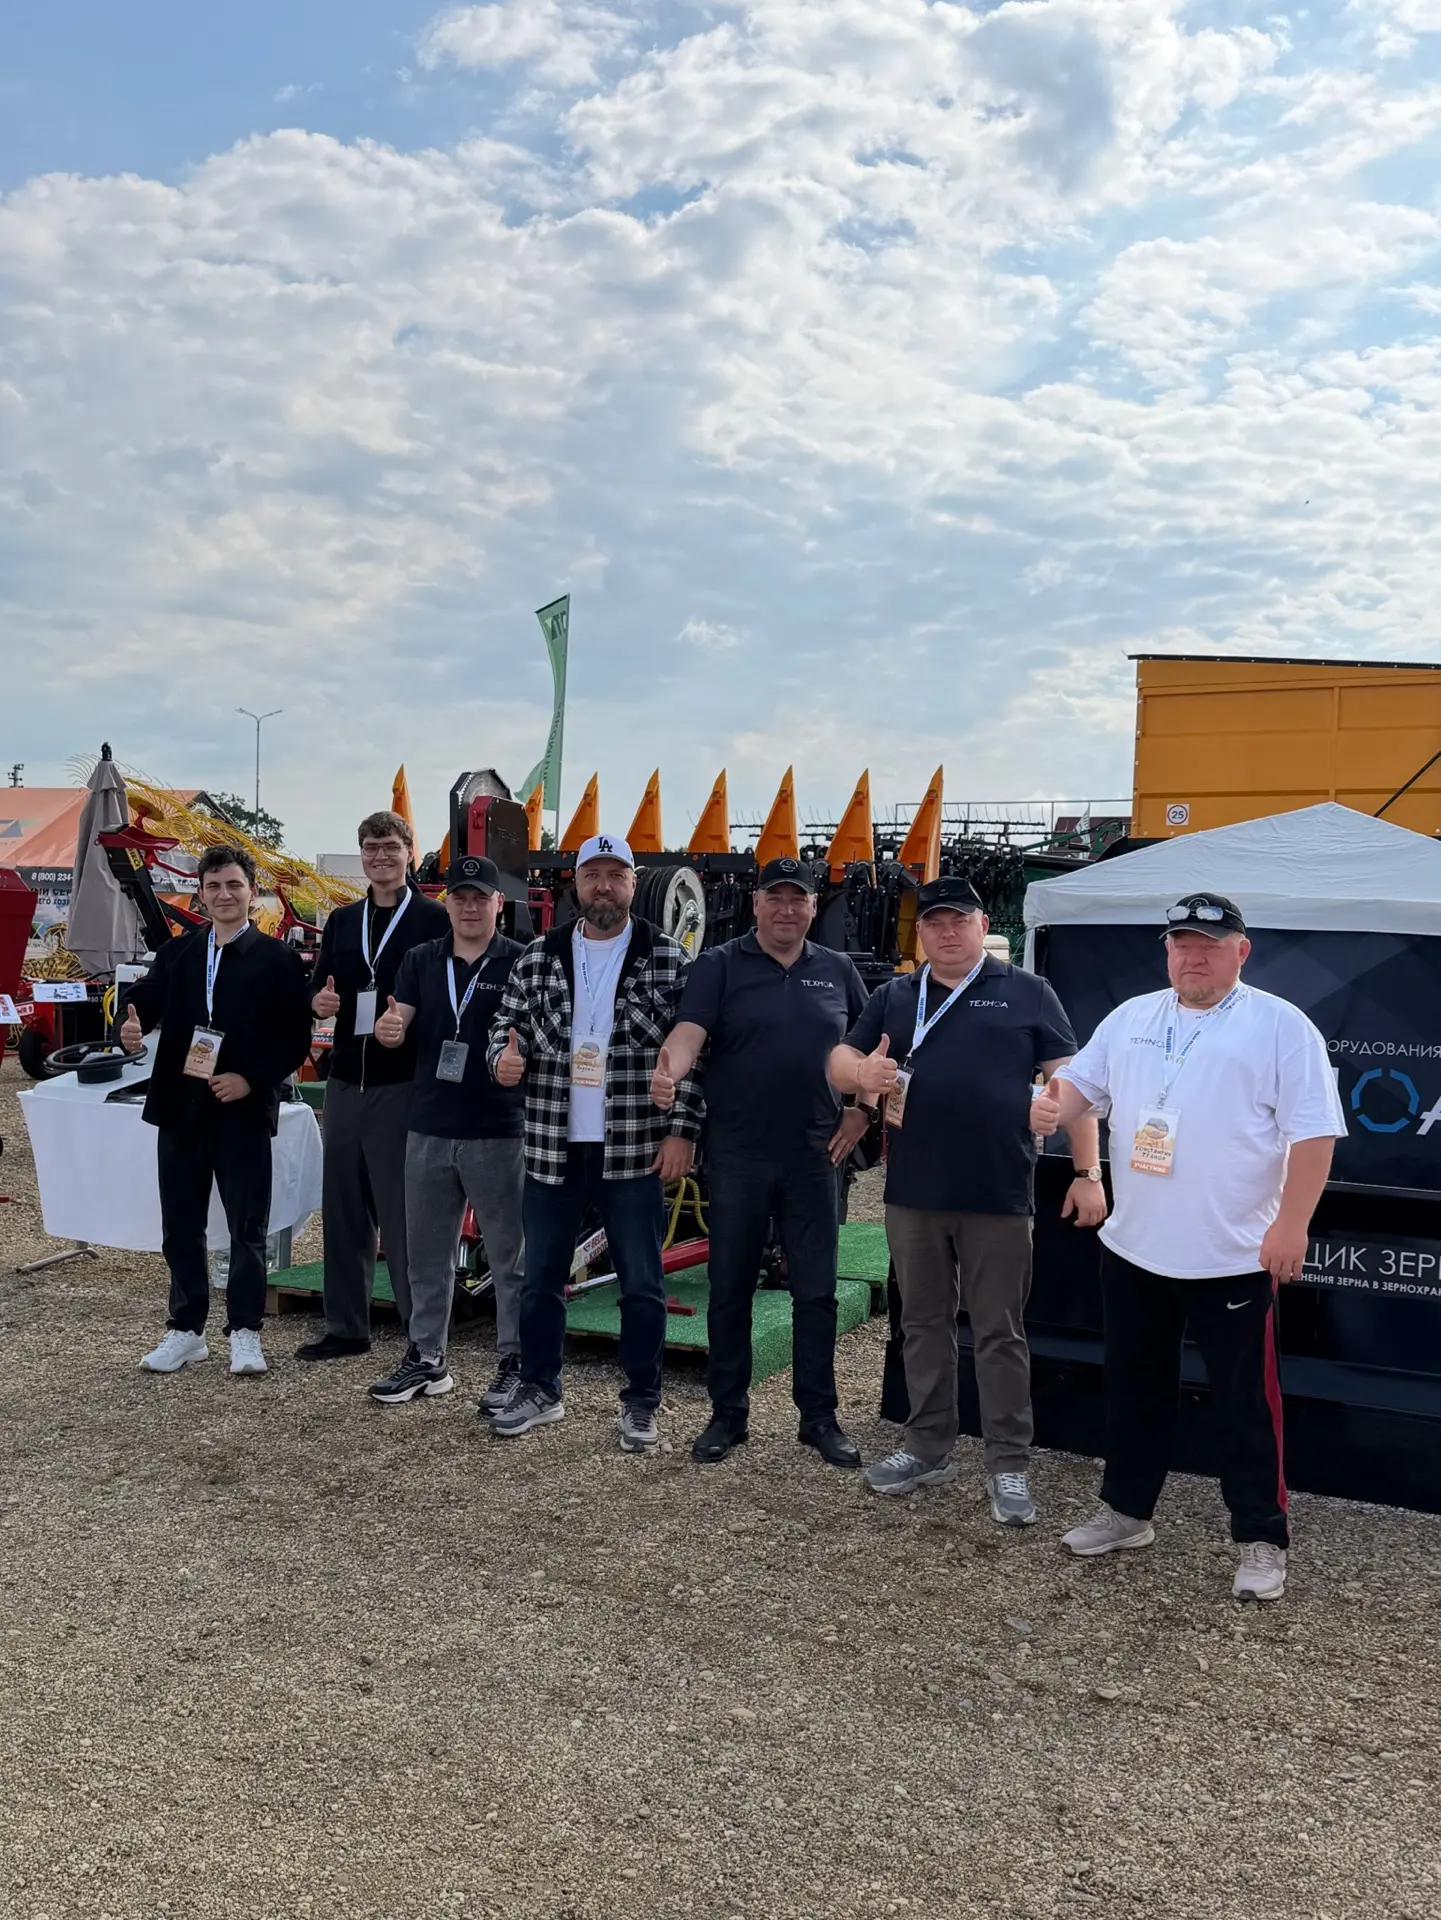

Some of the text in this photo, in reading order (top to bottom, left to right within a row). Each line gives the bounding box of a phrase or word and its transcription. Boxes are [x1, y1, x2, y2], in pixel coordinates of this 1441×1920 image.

[1171, 810, 1185, 820] 25
[598, 836, 613, 853] LA
[31, 872, 37, 880] 8
[38, 872, 56, 882] (800)
[968, 1000, 1009, 1009] ТЕХНОА
[1130, 1037, 1165, 1049] TEHNO
[1378, 1249, 1441, 1280] ЗЕР
[1336, 1276, 1370, 1289] ЗЕРНА
[1372, 1280, 1379, 1290] В
[1381, 1281, 1441, 1297] ЗЕРНОХРА
